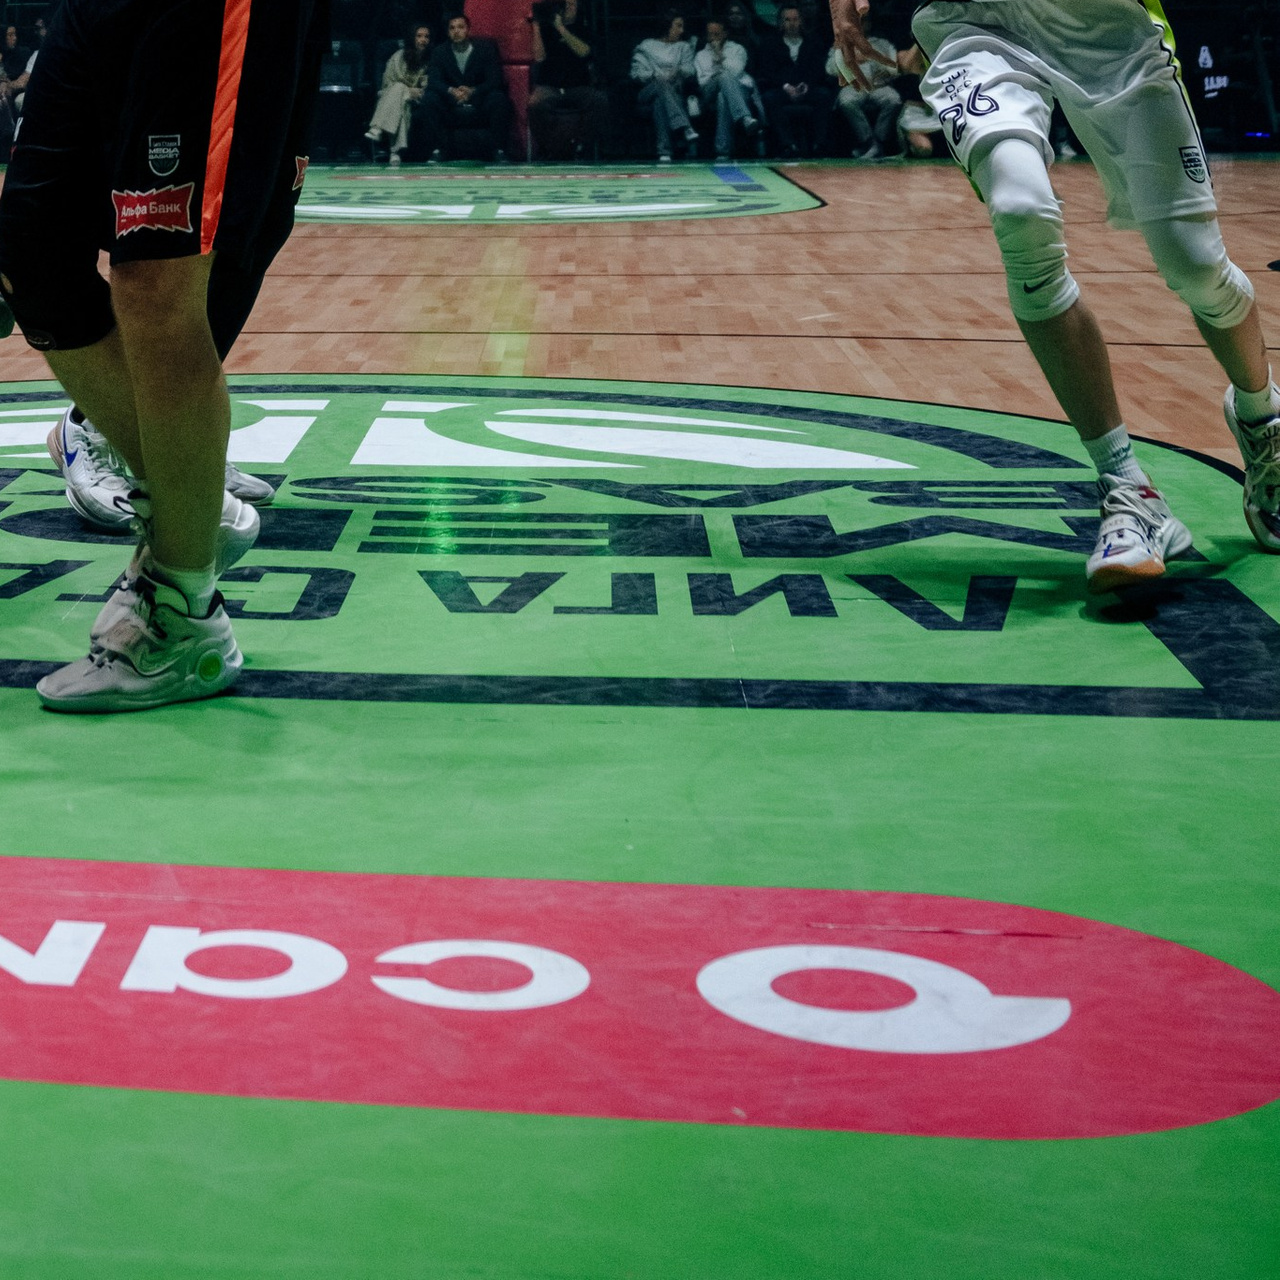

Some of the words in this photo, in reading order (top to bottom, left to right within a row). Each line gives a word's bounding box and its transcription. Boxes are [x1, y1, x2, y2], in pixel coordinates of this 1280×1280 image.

[939, 83, 1000, 146] 26
[121, 203, 147, 219] Альфа
[149, 201, 182, 215] Банк
